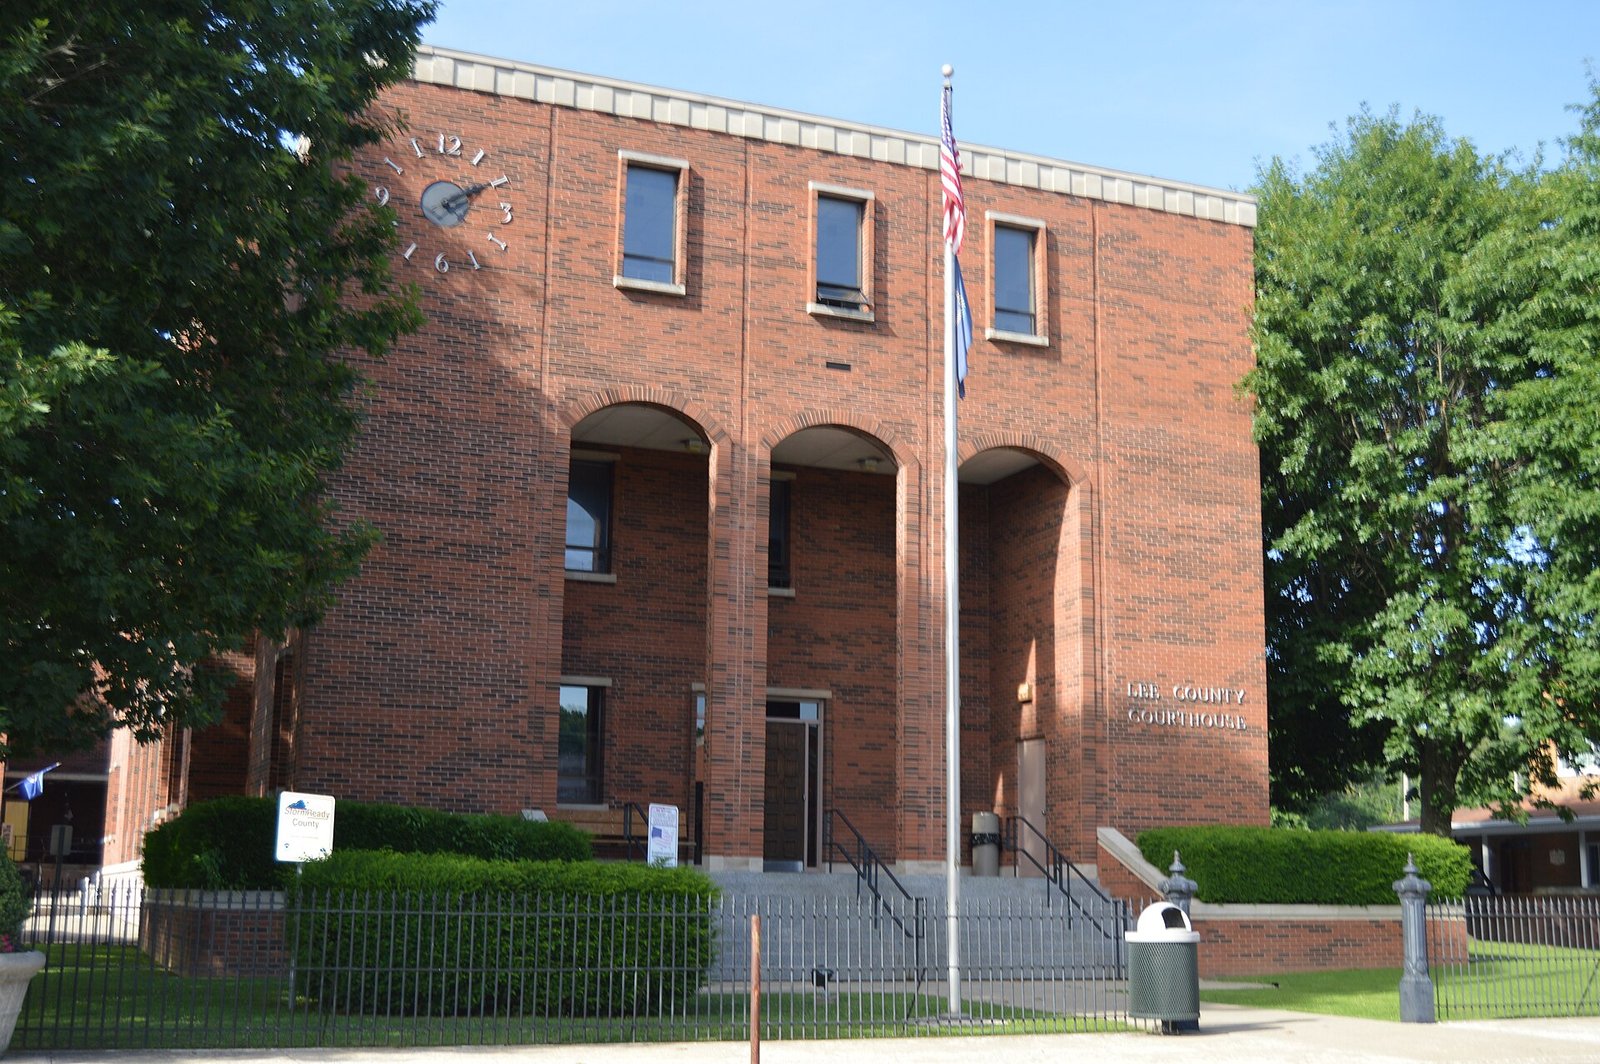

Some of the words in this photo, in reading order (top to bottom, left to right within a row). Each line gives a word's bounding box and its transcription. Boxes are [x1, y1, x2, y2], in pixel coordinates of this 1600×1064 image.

[438, 133, 462, 156] 12
[375, 186, 390, 208] 9
[500, 202, 513, 224] 3
[434, 252, 449, 274] 6
[1127, 682, 1160, 699] LEE
[1173, 685, 1246, 704] COUNTY
[1128, 708, 1247, 730] COURTHOUSE
[292, 818, 320, 829] County
